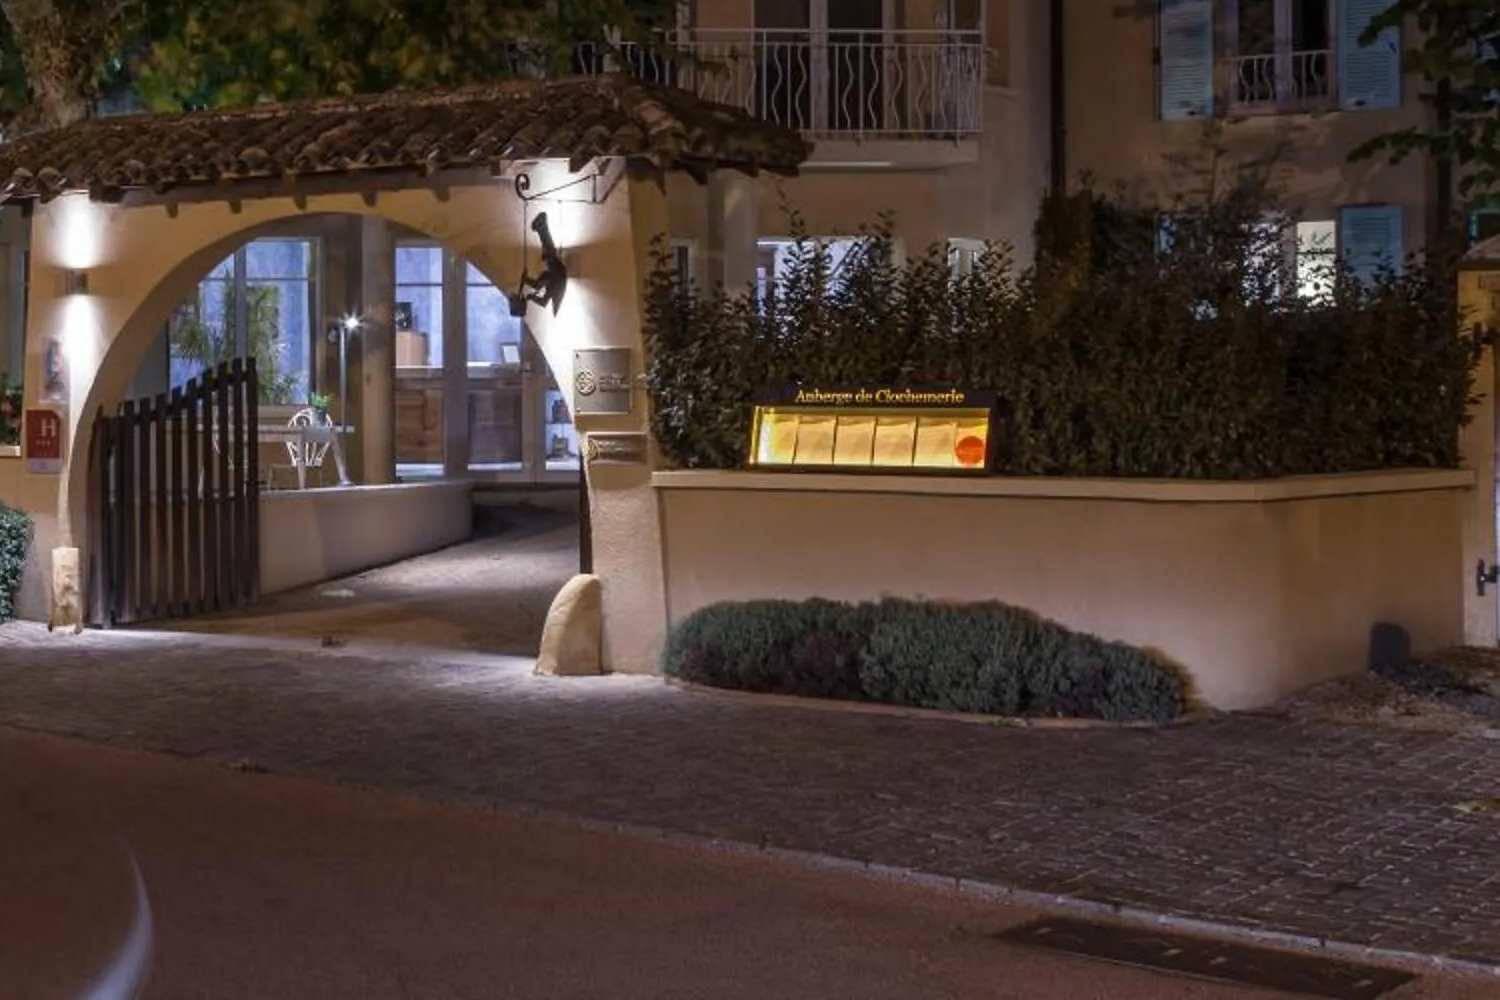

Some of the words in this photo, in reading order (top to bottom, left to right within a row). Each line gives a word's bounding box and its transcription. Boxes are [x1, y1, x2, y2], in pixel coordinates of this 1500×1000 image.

[795, 388, 853, 404] Auberge
[855, 388, 873, 403] de
[875, 387, 966, 404] Clochemerle
[41, 418, 57, 437] H
